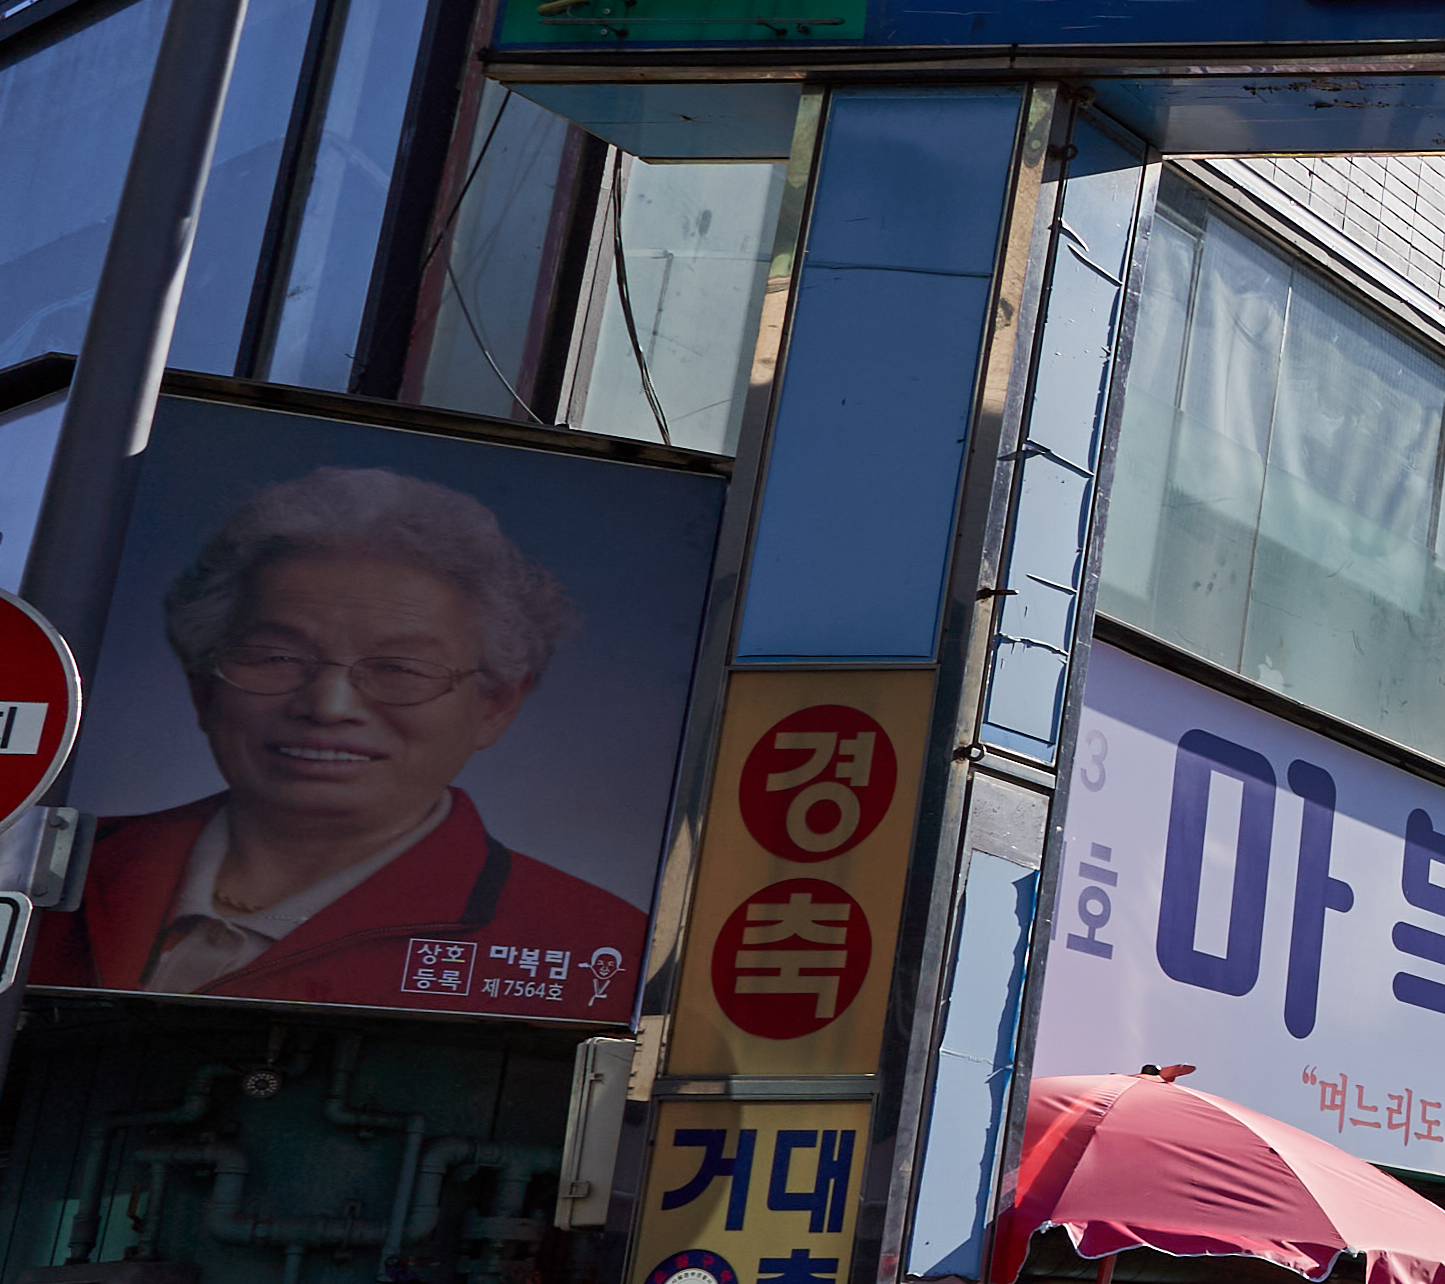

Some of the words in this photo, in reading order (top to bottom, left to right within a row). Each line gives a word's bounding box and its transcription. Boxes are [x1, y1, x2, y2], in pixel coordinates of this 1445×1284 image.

[416, 942, 466, 965] 상호
[488, 944, 571, 982] 마복림
[411, 967, 464, 992] 등록
